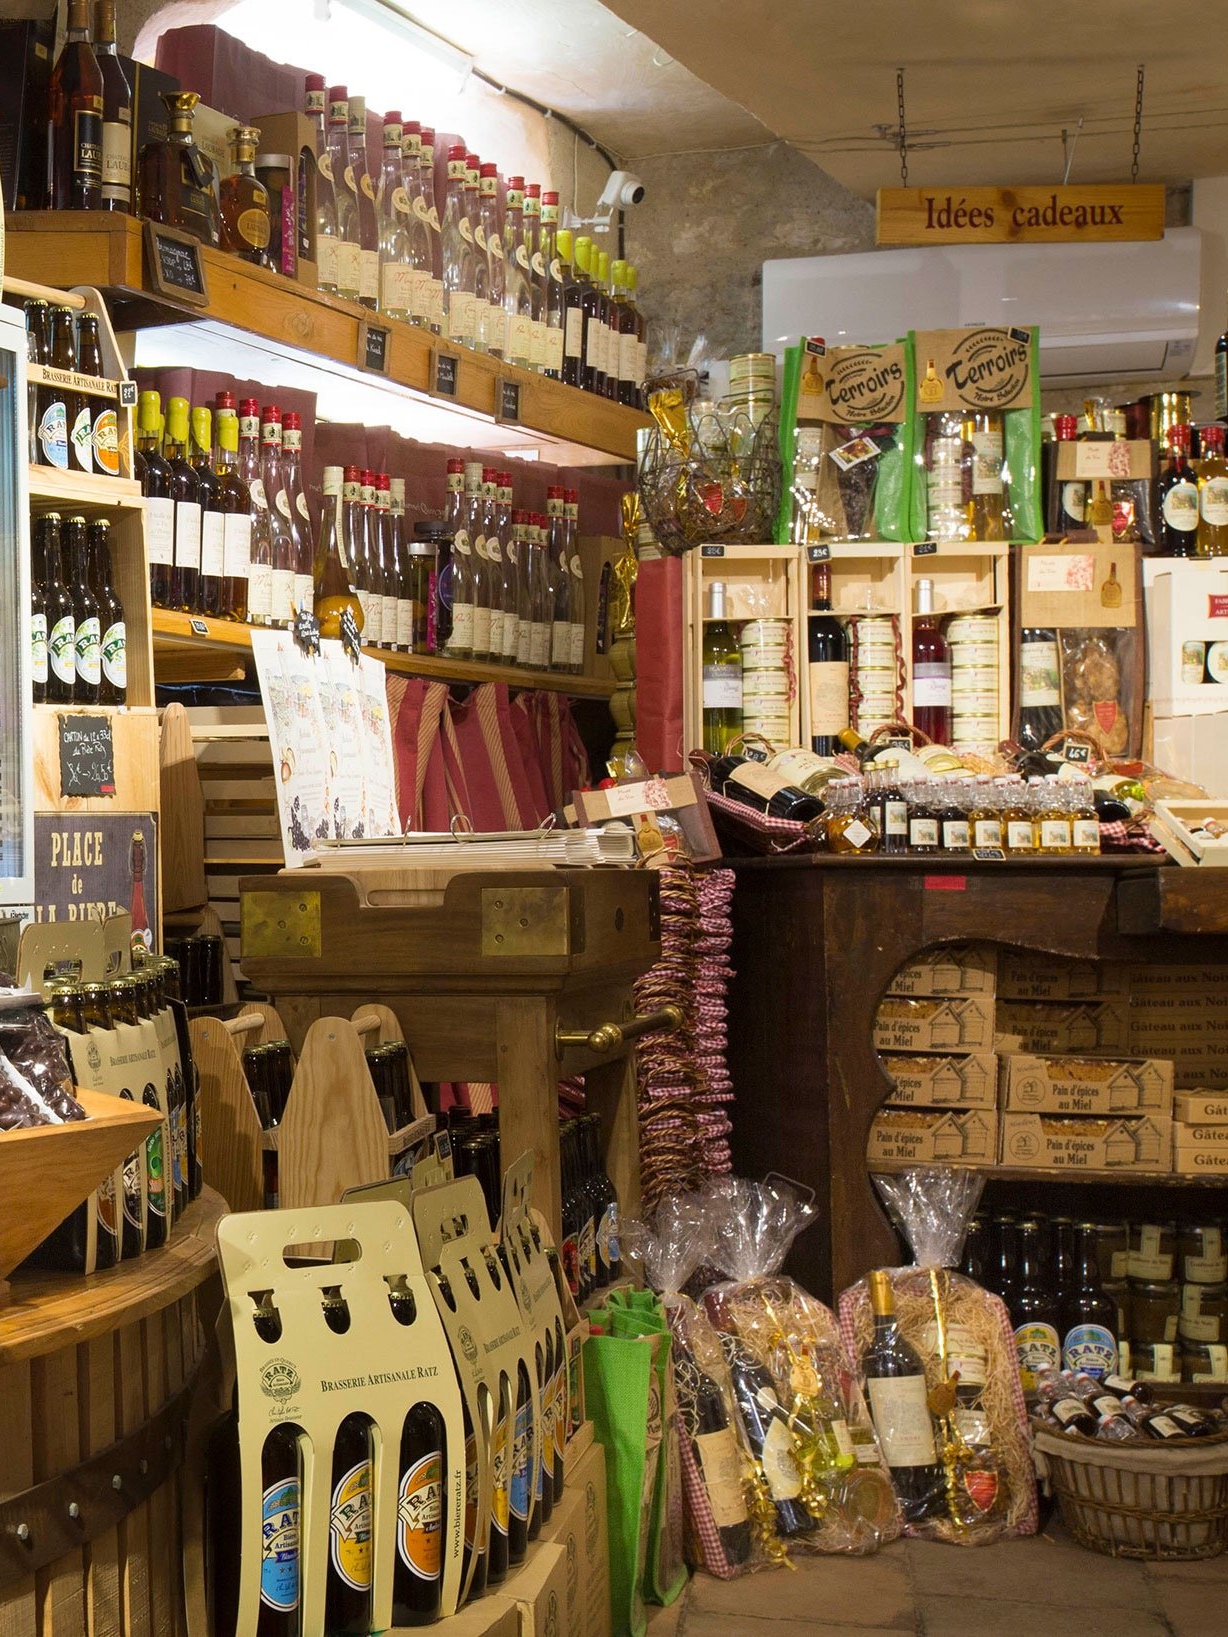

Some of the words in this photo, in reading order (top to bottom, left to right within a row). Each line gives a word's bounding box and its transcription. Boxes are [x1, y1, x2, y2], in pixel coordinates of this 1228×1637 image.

[925, 196, 995, 229] Idées
[1012, 194, 1124, 229] cadeaux
[945, 344, 1029, 391] Terroirs
[42, 368, 72, 385] BRASSERIE
[73, 377, 106, 391] ARTISANALE
[825, 361, 903, 407] Terroirs
[50, 831, 103, 867] PLACE
[71, 874, 83, 895] de
[894, 981, 915, 993] Miel
[873, 1021, 890, 1032] Pain
[891, 1020, 921, 1034] d'épices
[1179, 1023, 1202, 1031] aux
[879, 1037, 891, 1046] au
[893, 1035, 913, 1047] Miel
[1180, 1047, 1203, 1056] aux
[894, 1077, 922, 1090] 'épices
[1052, 1085, 1069, 1096] Pain
[1070, 1084, 1099, 1098] d'épices
[894, 1090, 914, 1102] Miel
[1058, 1101, 1070, 1110] au
[1071, 1099, 1092, 1111] Miel
[876, 1131, 892, 1142] Pain
[893, 1130, 923, 1145] d'épices
[882, 1147, 894, 1156] au
[896, 1146, 916, 1157] Miel
[1046, 1139, 1063, 1150] Pain
[1064, 1138, 1095, 1154] d'épices
[1052, 1156, 1065, 1165] au
[1066, 1153, 1087, 1165] Miel
[1069, 1344, 1114, 1361] RATZ
[264, 1365, 294, 1382] RATZ
[321, 1378, 366, 1393] BRASSERIE
[367, 1369, 417, 1386] ARTISANALE
[417, 1366, 439, 1379] RATZ
[453, 1470, 462, 1559] www.biereratz.fr
